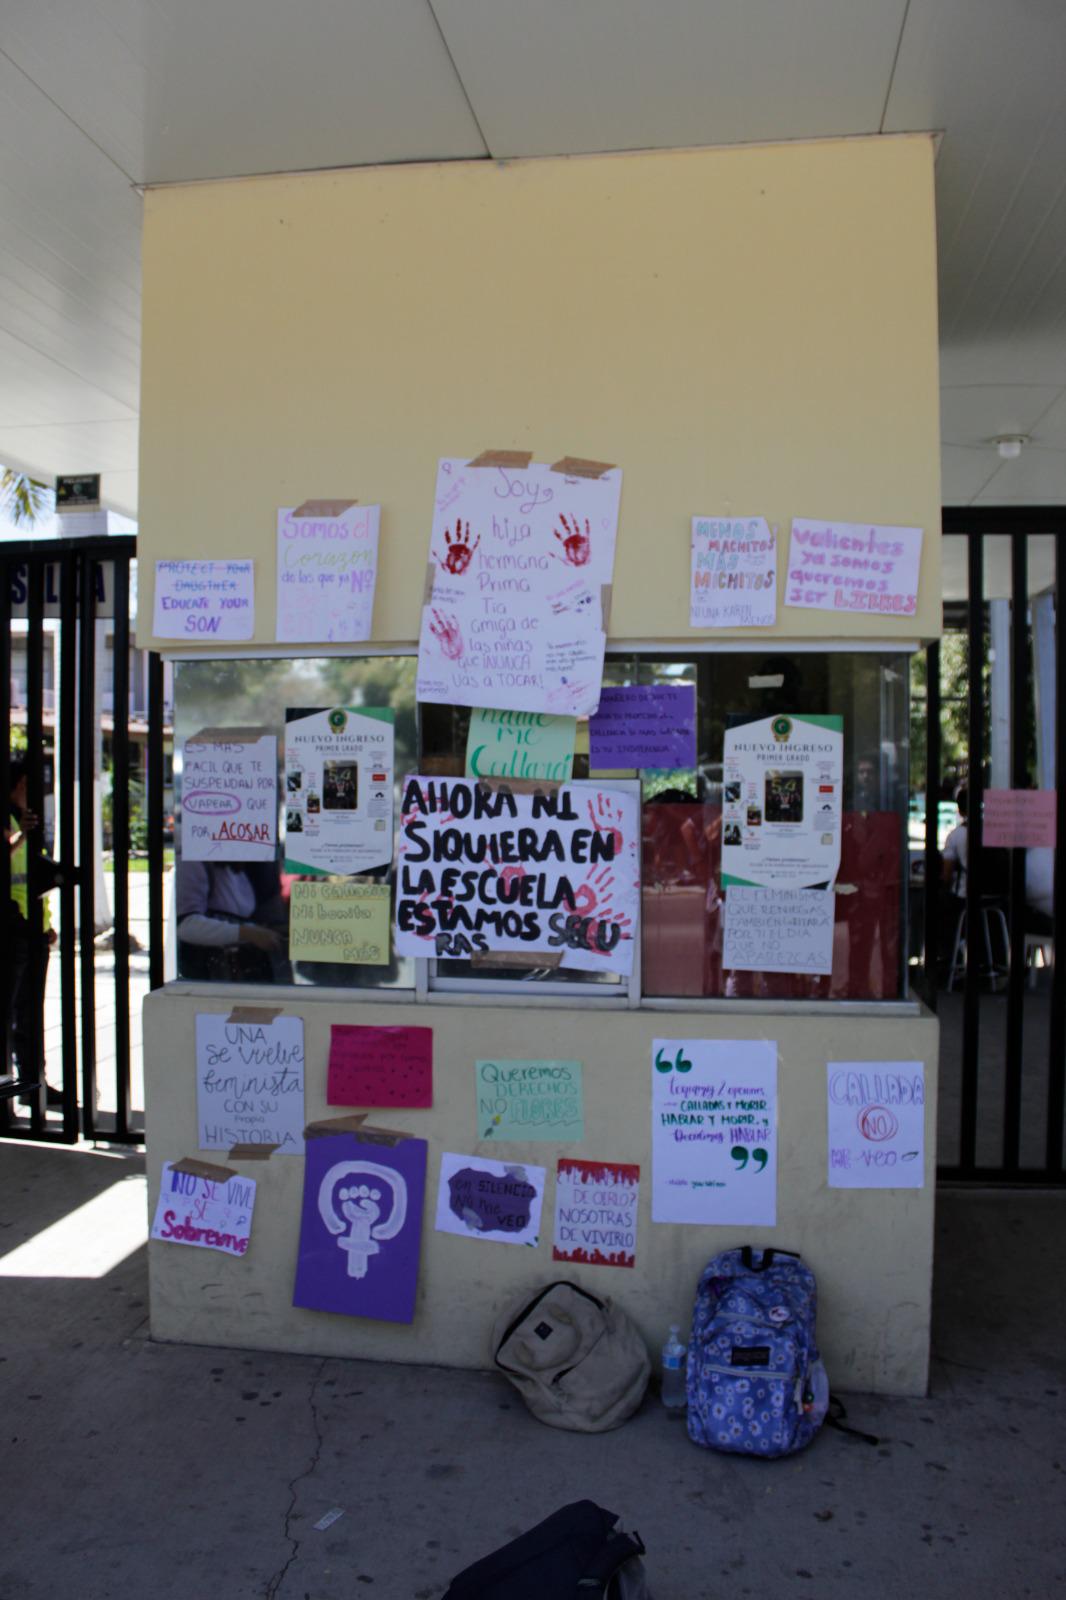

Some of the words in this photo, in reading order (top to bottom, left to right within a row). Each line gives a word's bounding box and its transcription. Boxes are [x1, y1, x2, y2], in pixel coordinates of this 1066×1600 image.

[282, 512, 349, 539] Somos
[353, 512, 370, 539] el
[493, 515, 531, 546] hija
[697, 521, 758, 540] MENOS
[708, 537, 775, 553] MACHITOS
[157, 561, 214, 575] PROTECT
[227, 561, 252, 574] YOUR
[479, 550, 549, 571] hermana
[318, 571, 335, 588] que
[694, 570, 776, 590] MICHITOS
[790, 570, 888, 592] queremos
[161, 596, 210, 610] EDUCATE
[220, 598, 249, 609] YOUR
[789, 587, 827, 603] ser
[834, 589, 918, 612] LIBRES
[184, 615, 222, 632] SON
[470, 620, 518, 640] amiga
[521, 616, 539, 630] de
[469, 638, 489, 654] las
[294, 734, 333, 744] NUEVO
[336, 734, 385, 744] INGRESO
[314, 744, 339, 752] PRIMER
[341, 744, 364, 752] GRADO
[734, 743, 775, 753] NUEVO
[780, 743, 834, 753] INGRESO
[756, 753, 783, 762] PRIMER
[785, 753, 811, 762] GRADO
[222, 760, 244, 775] QUE
[250, 760, 263, 773] TE
[184, 776, 254, 790] SUSPENDAN
[257, 777, 275, 789] POR
[188, 798, 233, 809] VAPEAR
[246, 798, 269, 811] QUE
[402, 779, 518, 821] AHORA
[532, 787, 579, 821] NI
[191, 825, 209, 838] POR
[219, 820, 271, 840] ACOSAR
[404, 820, 565, 864] SIQUIERA
[571, 828, 615, 864] EN
[402, 865, 436, 895] LA
[440, 867, 577, 911] ESCUELA
[398, 900, 541, 941] ESTAMOS
[435, 933, 490, 956] RAS
[225, 1025, 267, 1044] UNA
[203, 1067, 305, 1098] feminista
[494, 1081, 578, 1098] DERECHOS
[830, 1071, 925, 1106] CALLADA
[224, 1100, 256, 1113] CON
[260, 1099, 278, 1113] SU
[480, 1098, 507, 1114] NO
[681, 1100, 725, 1112] CALLADAS
[661, 1113, 704, 1126] HABLAR
[864, 1115, 887, 1136] NO
[204, 1125, 297, 1146] HISTORIA
[171, 1169, 197, 1196] NO
[478, 1180, 536, 1198] SILENCIO
[573, 1189, 589, 1204] DE
[496, 1214, 527, 1228] VEO
[558, 1208, 633, 1228] NOSOTRAS
[560, 1226, 577, 1241] DE
[581, 1229, 634, 1249] VIVIRLO
